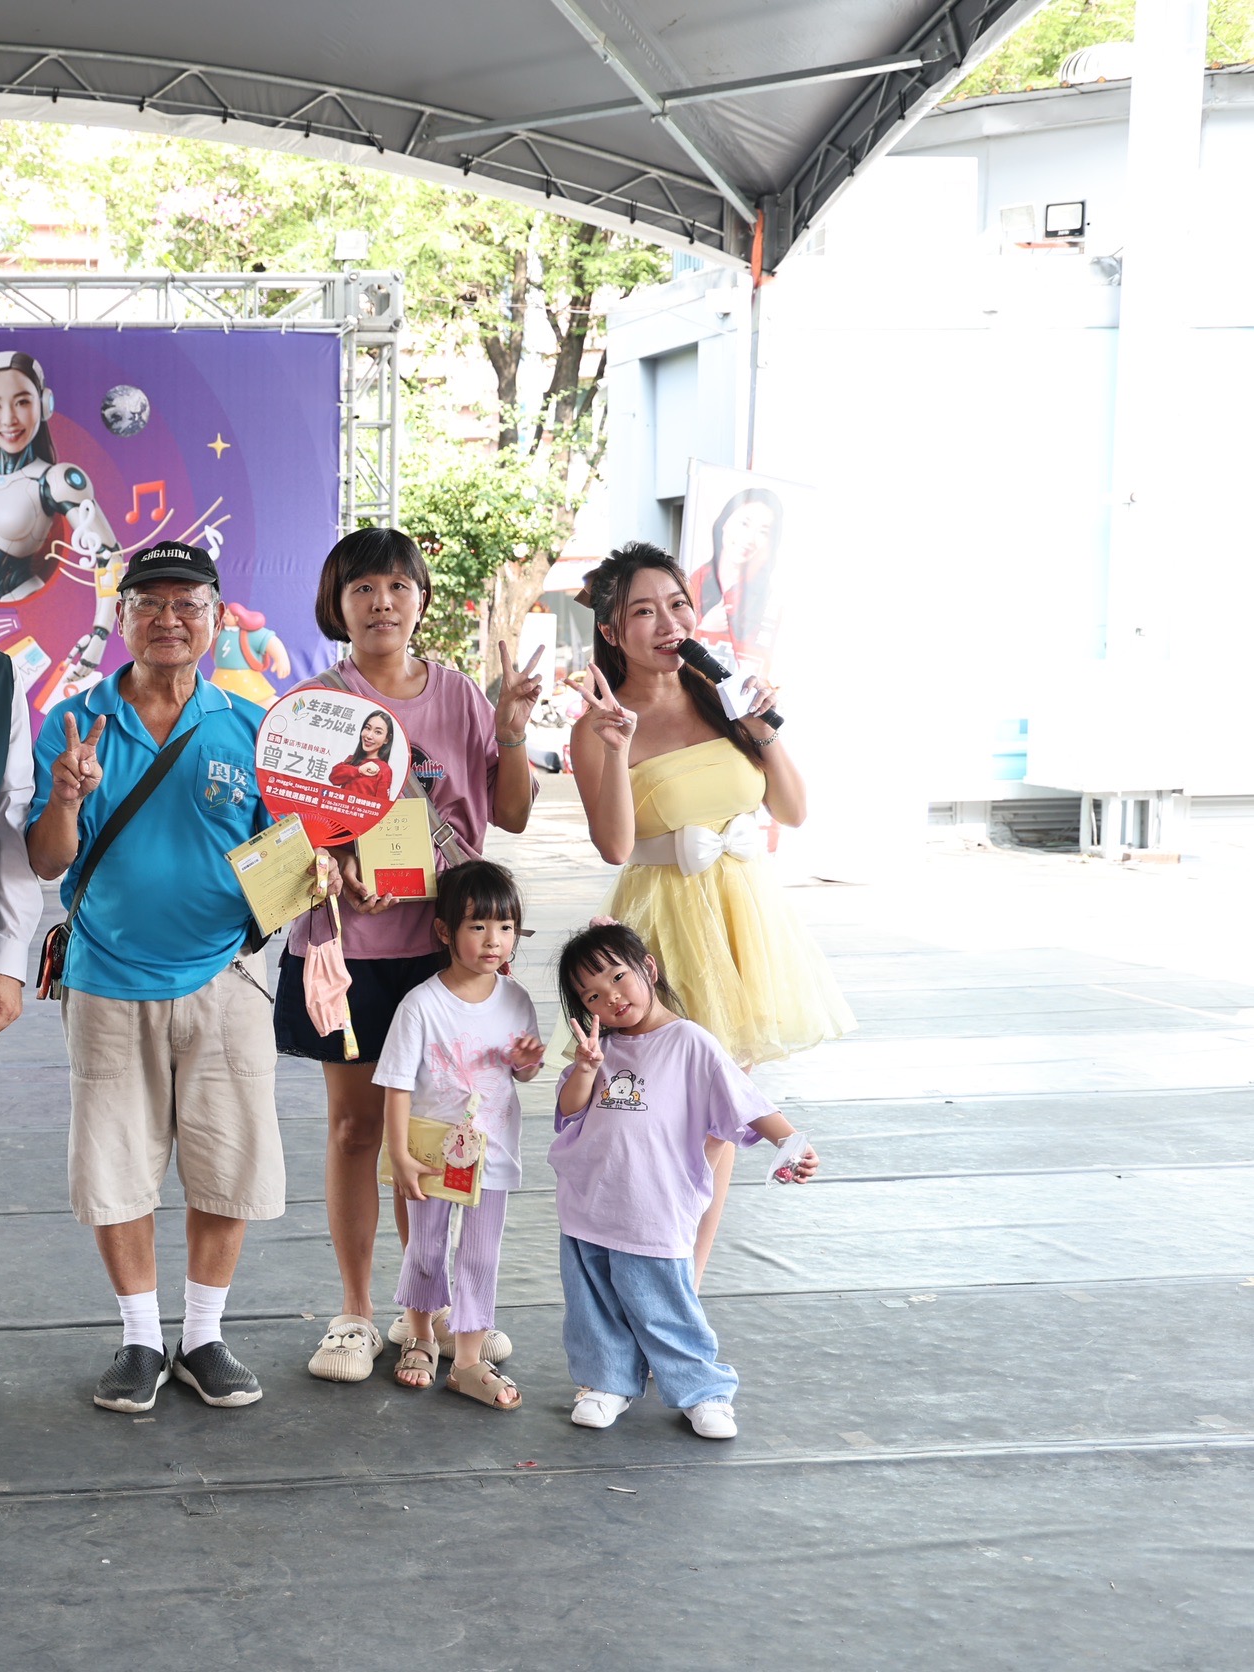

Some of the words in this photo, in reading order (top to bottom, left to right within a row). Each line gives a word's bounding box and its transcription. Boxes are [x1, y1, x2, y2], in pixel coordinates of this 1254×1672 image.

[306, 699, 355, 720] 生活東區
[309, 714, 356, 736] 全力以赴
[283, 738, 331, 756] 東區市議員候選人
[262, 745, 329, 780] 曾之婕
[412, 759, 446, 780] tellite
[391, 842, 401, 851] 16
